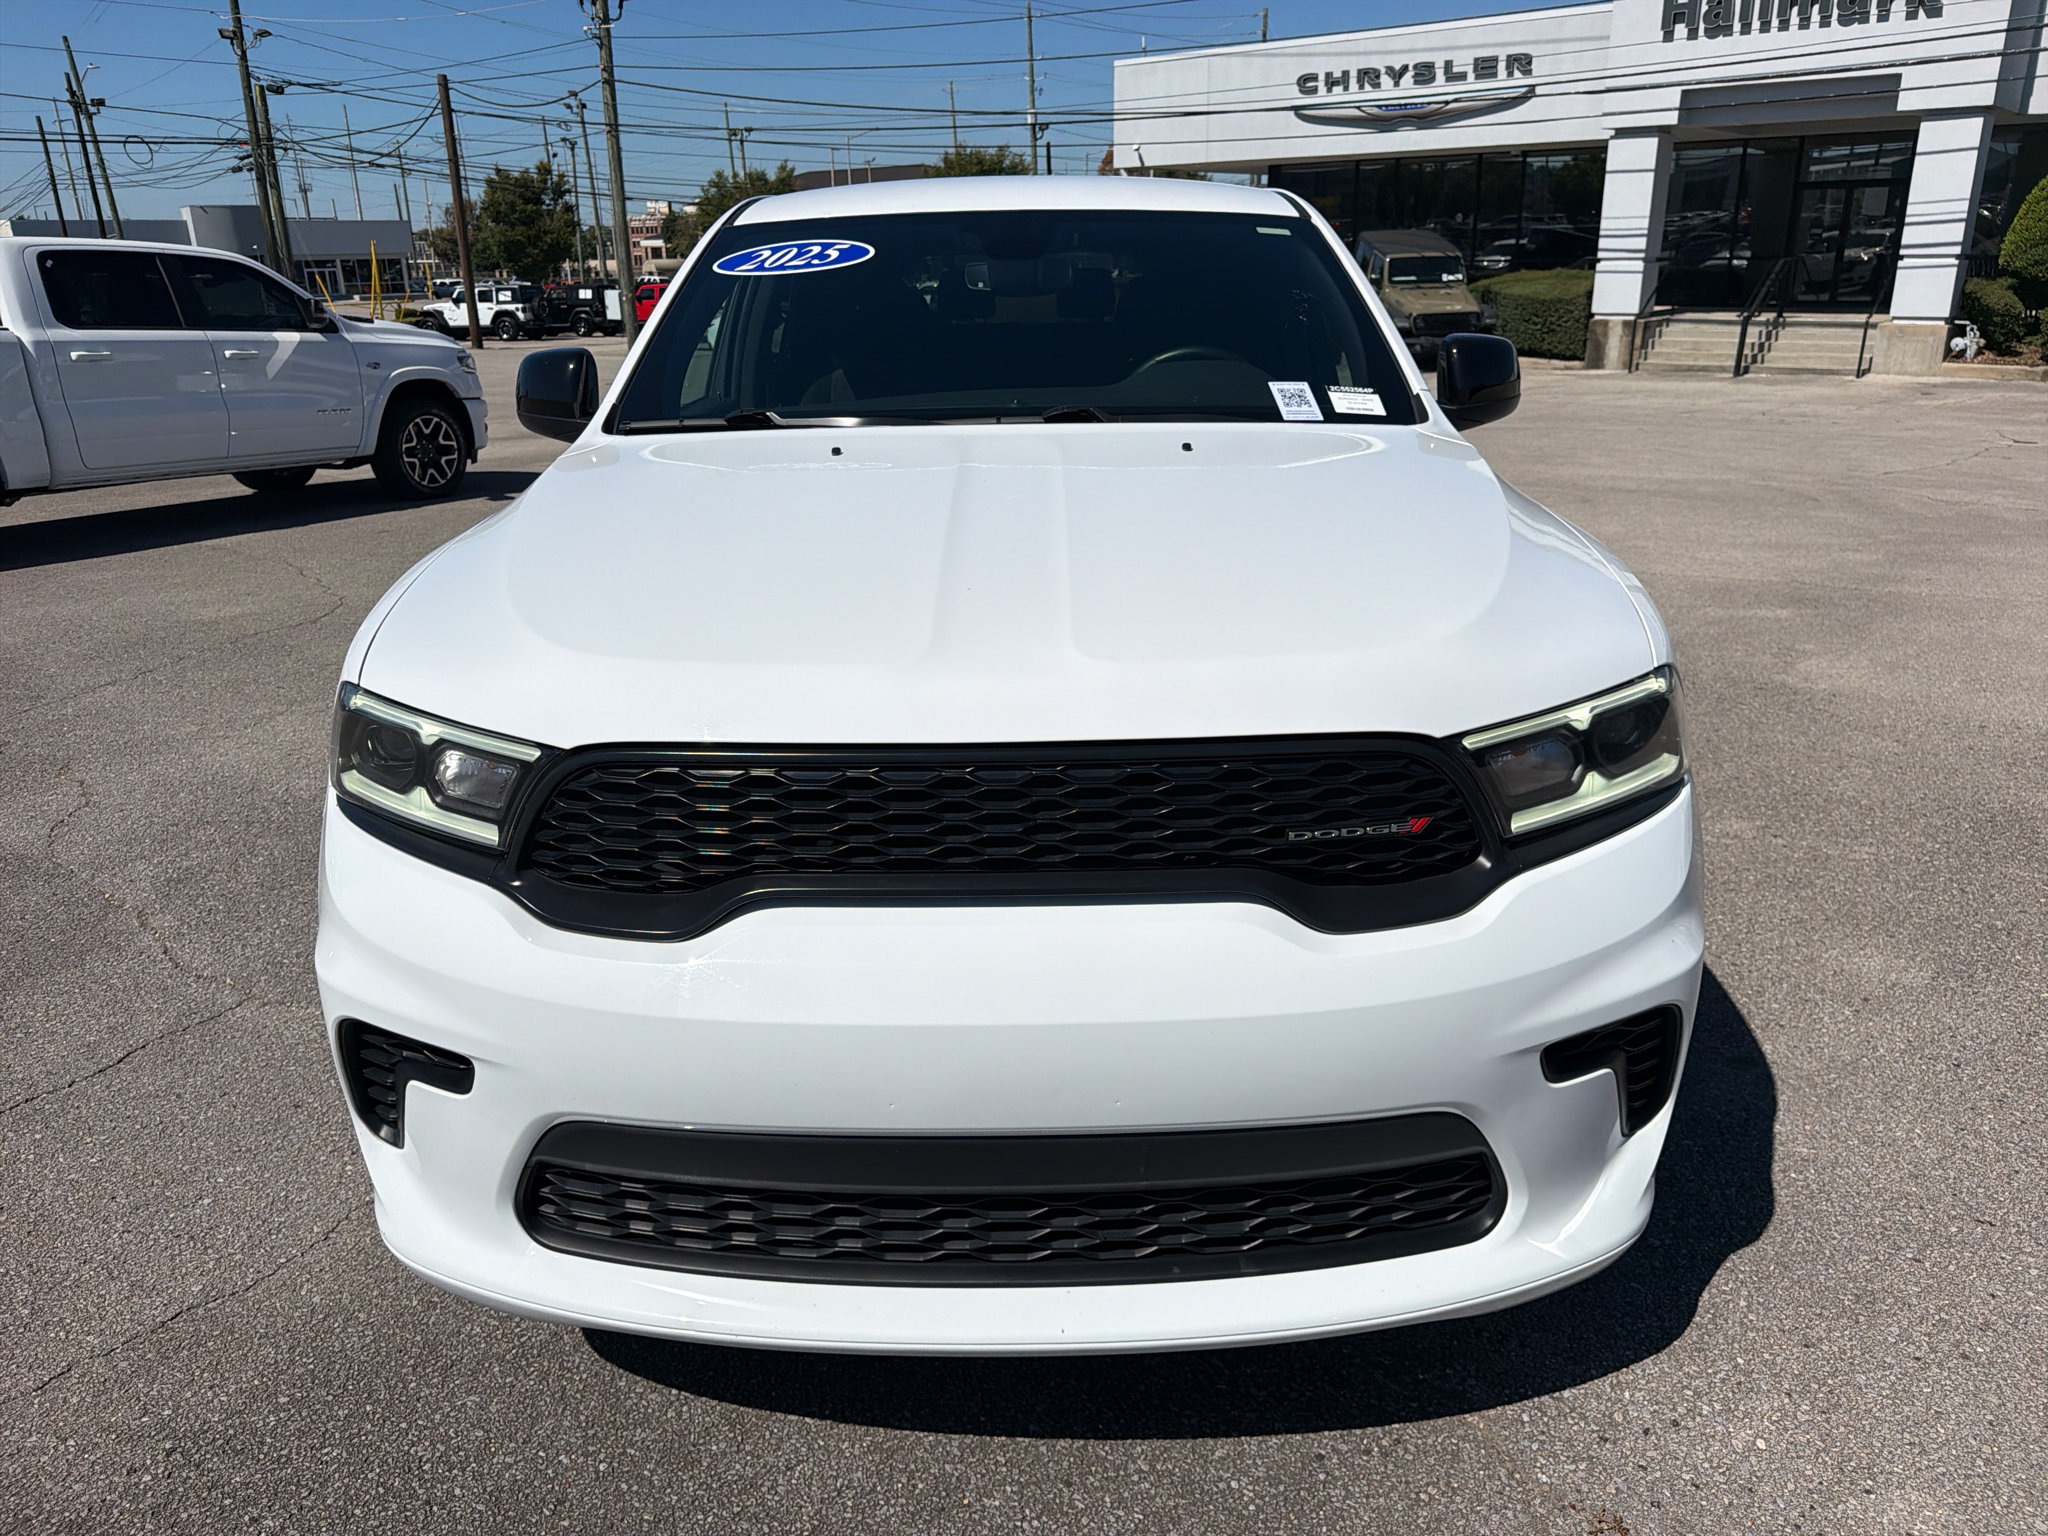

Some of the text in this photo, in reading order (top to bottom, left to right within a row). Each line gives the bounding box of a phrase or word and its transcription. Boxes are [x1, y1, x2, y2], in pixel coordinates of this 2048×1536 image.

[1661, 0, 1943, 41] Hallm
[1296, 52, 1533, 94] CHRYSLER
[734, 244, 852, 272] 2025
[1287, 821, 1413, 841] DODGE
